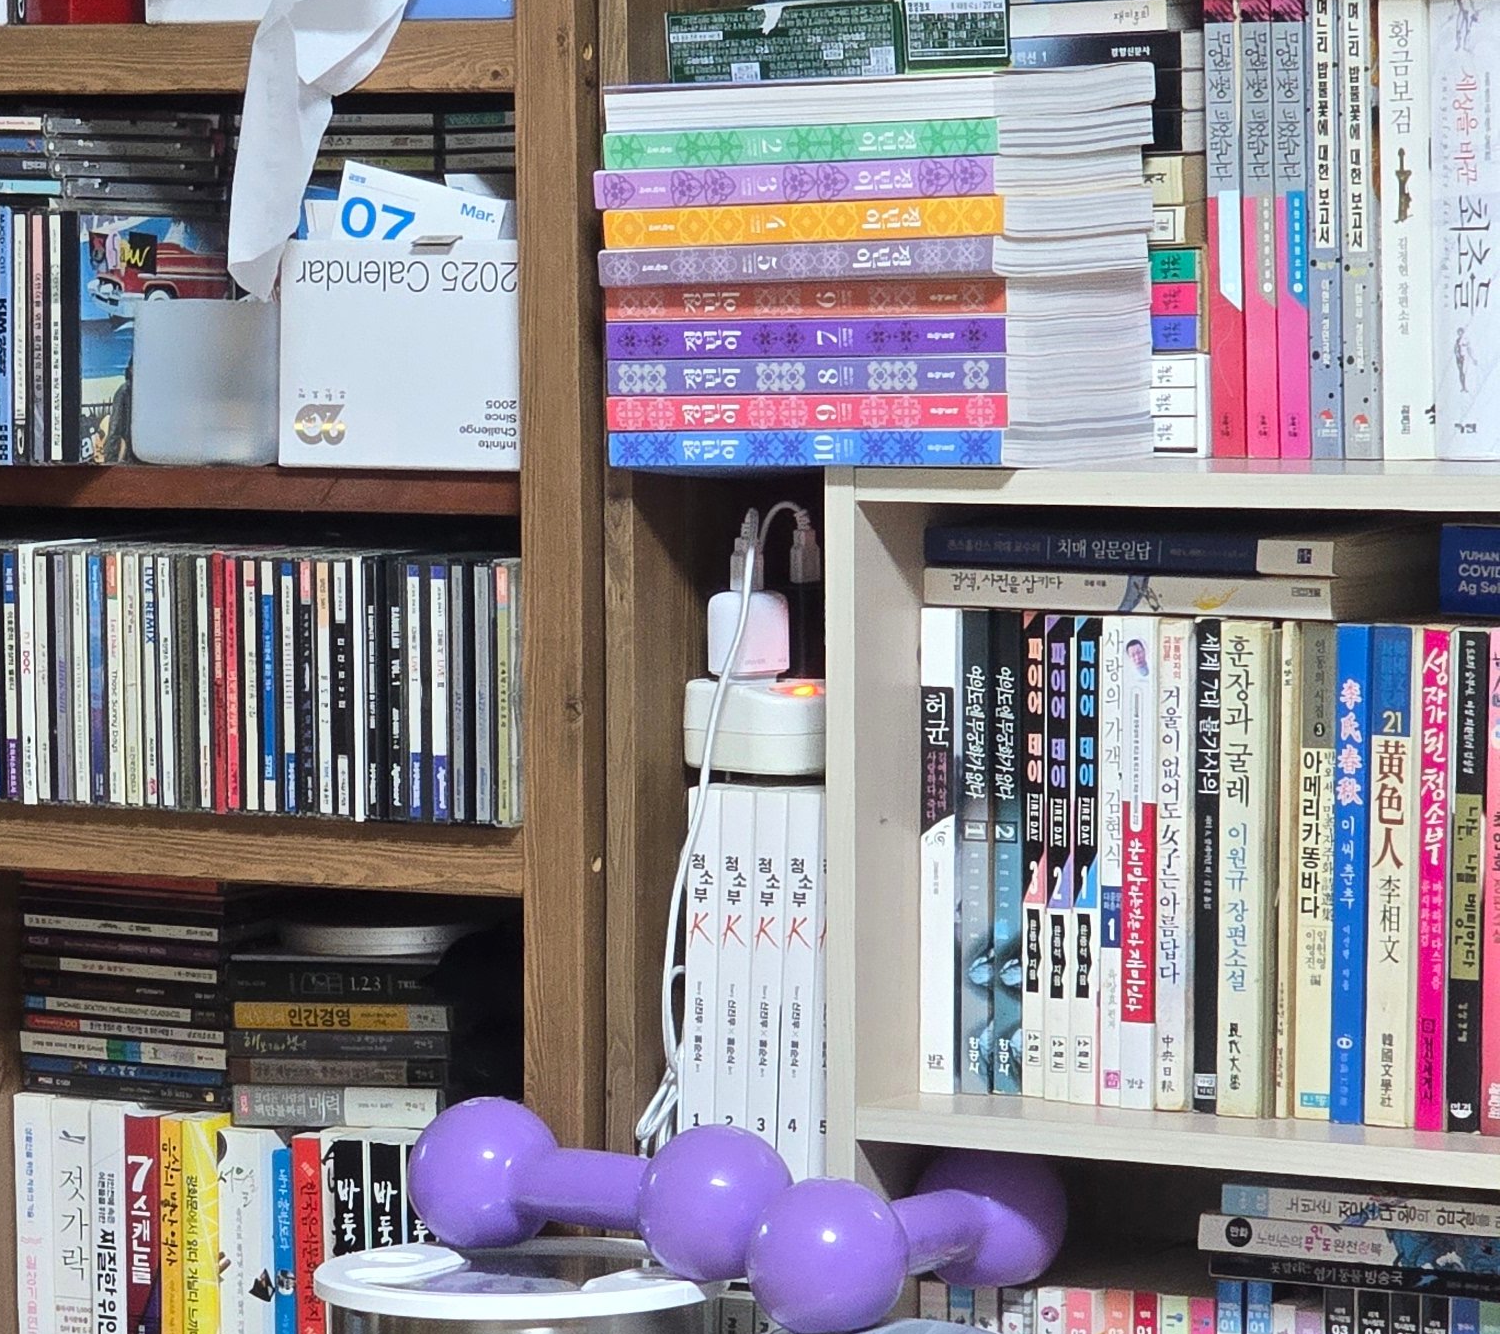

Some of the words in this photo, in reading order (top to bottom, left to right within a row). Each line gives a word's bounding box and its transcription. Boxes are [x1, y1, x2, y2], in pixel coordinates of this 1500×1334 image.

[1110, 46, 1151, 59] 경향신문사
[1276, 29, 1300, 104] 무궁화꽃이
[1388, 18, 1414, 136] 황금보검
[1317, 61, 1329, 137] 밥풀꽃에
[1453, 70, 1479, 136] 세상을
[761, 137, 784, 154] 2
[858, 129, 917, 153] 정년이
[1277, 109, 1301, 183] 피었습니다
[1318, 144, 1330, 181] 대한
[1453, 140, 1479, 185] 바꾼
[341, 197, 415, 240] 07
[460, 203, 496, 224] Mar.
[861, 206, 921, 231] 정년이
[1318, 188, 1331, 244] 보고서
[296, 260, 430, 292] Calendar
[442, 261, 518, 292] 2025
[684, 329, 742, 353] 정년이
[817, 330, 838, 347] 7
[683, 367, 741, 390] 정년이
[818, 368, 839, 385] 8
[484, 413, 517, 423] Since
[485, 400, 517, 410] 2005
[682, 403, 741, 425] 정년이
[815, 404, 838, 422] 9
[459, 425, 517, 438] Challenge
[478, 439, 517, 450] Infinite
[683, 438, 740, 461] 정년이
[813, 434, 835, 462] 10
[1057, 539, 1087, 561] 치매
[1092, 539, 1152, 561] 일문일답
[144, 566, 156, 593] LIVE
[951, 570, 980, 591] 검색,
[982, 573, 1021, 593] 사전을
[1023, 574, 1064, 595] 삼키다
[144, 601, 156, 644] REMIX
[1104, 632, 1123, 705] 사랑의
[1199, 632, 1221, 671] 세계
[1080, 640, 1096, 718] 파이어
[1199, 678, 1221, 711] 7대
[1224, 634, 1254, 736] 훈장과
[1422, 647, 1448, 724] 성자가
[924, 692, 950, 748] 허균
[1160, 686, 1182, 753] 거울이
[1383, 711, 1402, 734] 21
[1080, 736, 1095, 788] 데이
[1104, 718, 1123, 779] 가객,
[1198, 714, 1220, 797] 불가사의
[1423, 728, 1446, 762] 된
[1161, 756, 1182, 820] 없어도
[1224, 742, 1254, 809] 굴레
[1080, 797, 1091, 824] FIRE
[1104, 791, 1123, 868] 김현식
[1422, 767, 1446, 866] 청소부
[1080, 828, 1091, 846] DAY
[1301, 751, 1323, 919] 아메리카똥바다
[1224, 822, 1248, 892] 이원규
[1339, 815, 1356, 910] 이씨춘추
[757, 857, 780, 907] 청소부
[1158, 890, 1181, 985] 아름답다
[1379, 876, 1401, 965] 李相文
[1224, 899, 1248, 993] 장편소설
[287, 1007, 352, 1028] 인간경영
[308, 1093, 341, 1120] 매력
[59, 1165, 90, 1282] 젓가락
[185, 1175, 199, 1236] 광화문에서
[338, 1178, 361, 1249] 바둑
[374, 1180, 399, 1248] 바둑
[185, 1238, 199, 1264] 읽다
[1256, 1232, 1302, 1250] 노빈손의
[96, 1228, 118, 1298] 찌질한
[1364, 1269, 1404, 1287] 방송국
[186, 1268, 199, 1304] 거닐다
